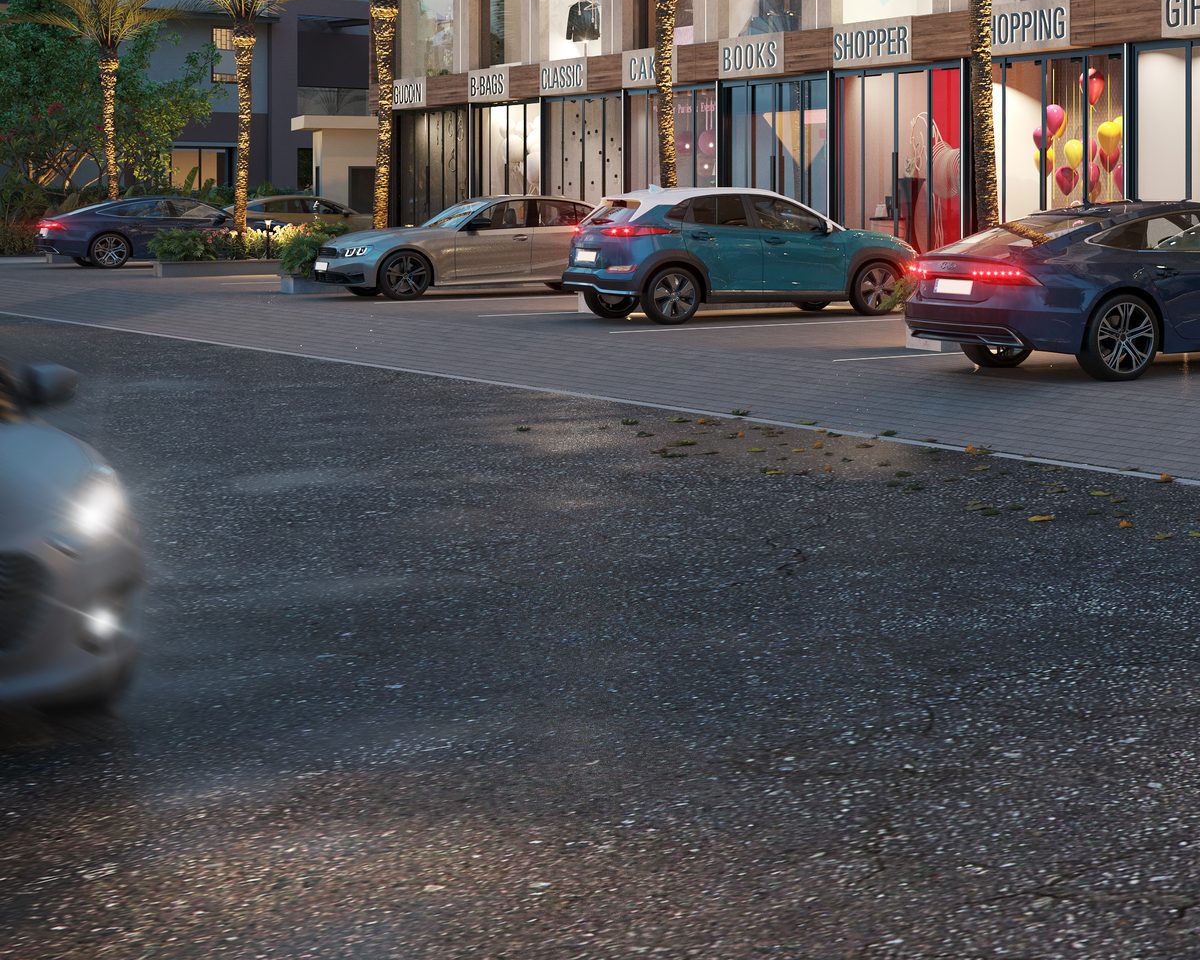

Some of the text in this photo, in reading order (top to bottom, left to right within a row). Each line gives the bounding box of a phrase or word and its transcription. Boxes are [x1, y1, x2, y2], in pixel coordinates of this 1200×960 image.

[722, 41, 778, 72] BOOKS
[834, 26, 909, 61] SHOPPER
[541, 64, 584, 90] CLASSIC
[629, 56, 656, 81] CAK
[470, 73, 504, 97] B-BAGS
